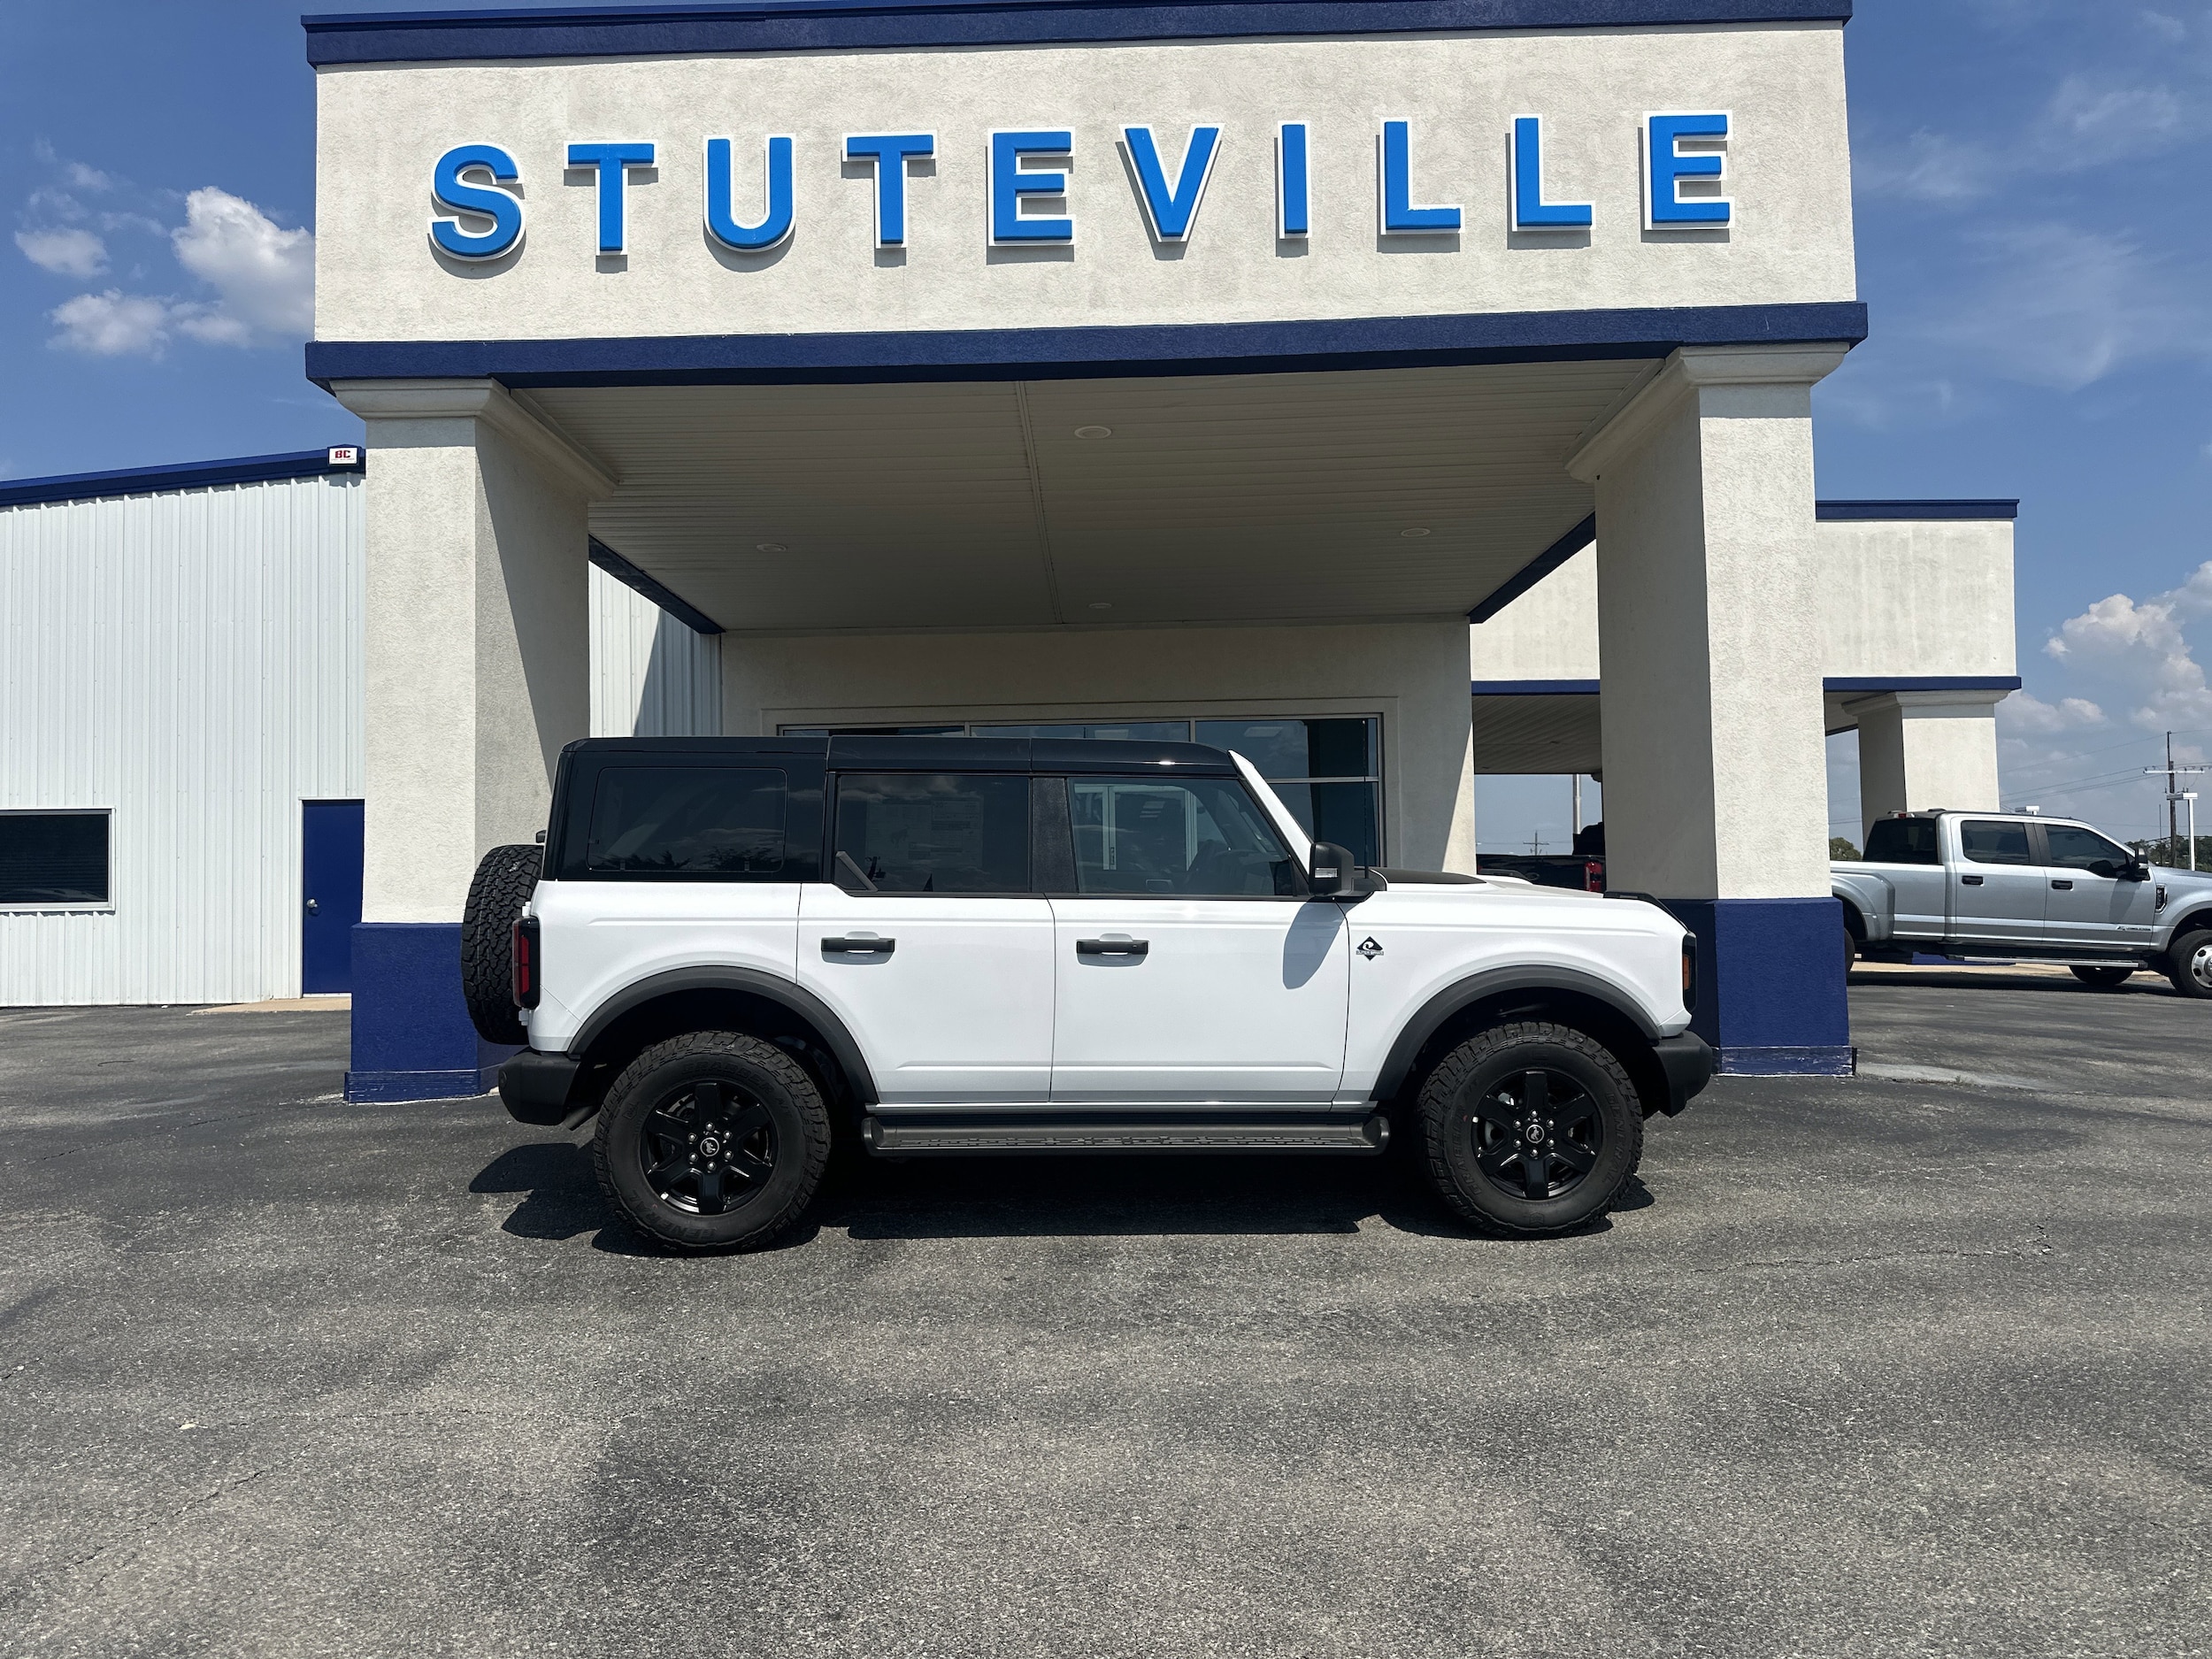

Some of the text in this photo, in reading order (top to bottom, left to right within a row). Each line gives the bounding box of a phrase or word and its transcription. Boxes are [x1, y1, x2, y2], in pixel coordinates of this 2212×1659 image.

[429, 111, 1733, 259] STUTEVILLE
[334, 449, 351, 458] BC
[681, 1060, 775, 1096] GRABBER
[1451, 1104, 1483, 1196] GRABBER
[1601, 1092, 1626, 1184] GENERAL
[626, 1188, 717, 1240] GENERAL
